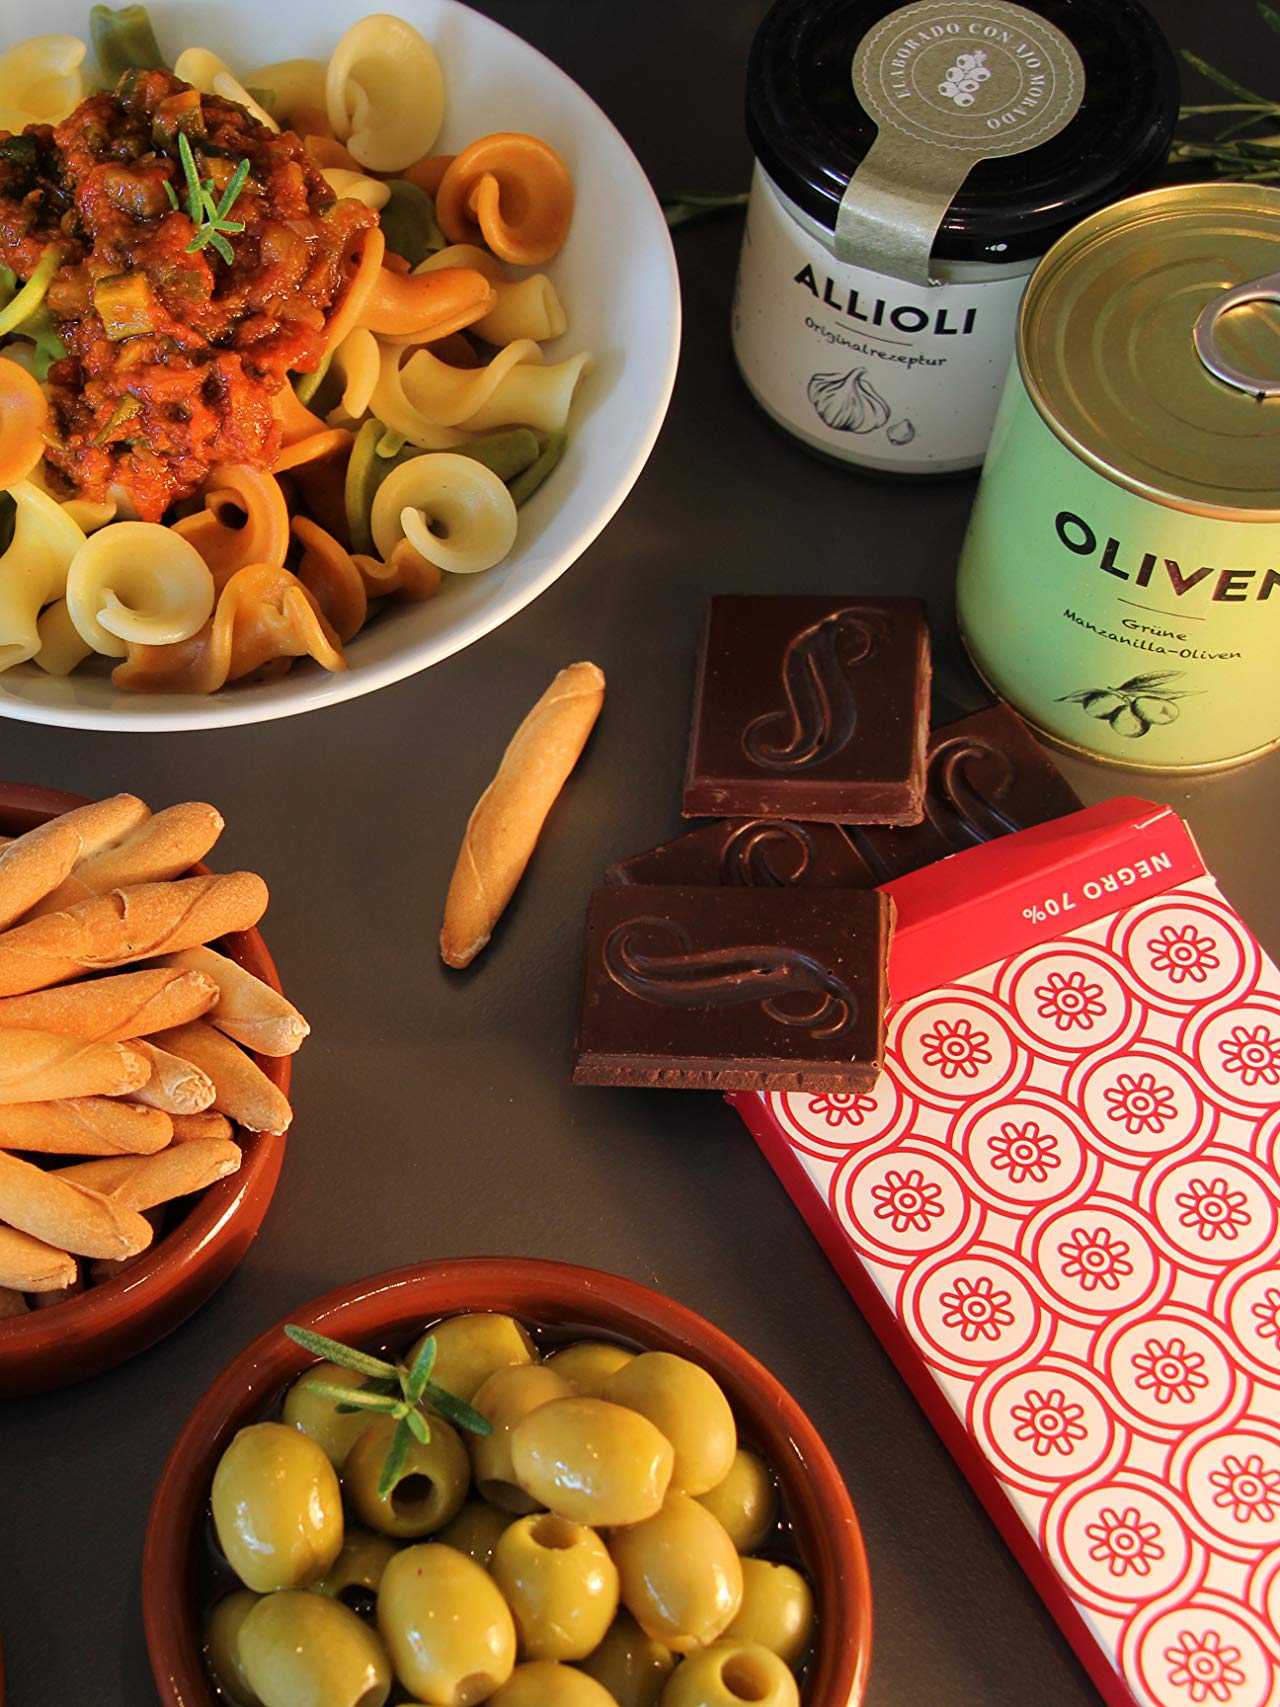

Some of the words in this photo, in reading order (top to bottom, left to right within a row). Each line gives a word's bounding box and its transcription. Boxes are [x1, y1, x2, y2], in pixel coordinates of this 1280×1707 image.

[968, 23, 1013, 44] CON
[1014, 43, 1042, 70] AJO
[890, 22, 960, 100] ELABORADO
[986, 73, 1045, 130] MORADO
[793, 263, 978, 335] ALLIOLI
[804, 316, 947, 370] Originalrezeptur
[1063, 608, 1243, 660] Manzanilla-Oliven
[1121, 618, 1190, 642] Grüne
[1082, 852, 1173, 901] NEGRO
[1021, 892, 1076, 924] 70%
